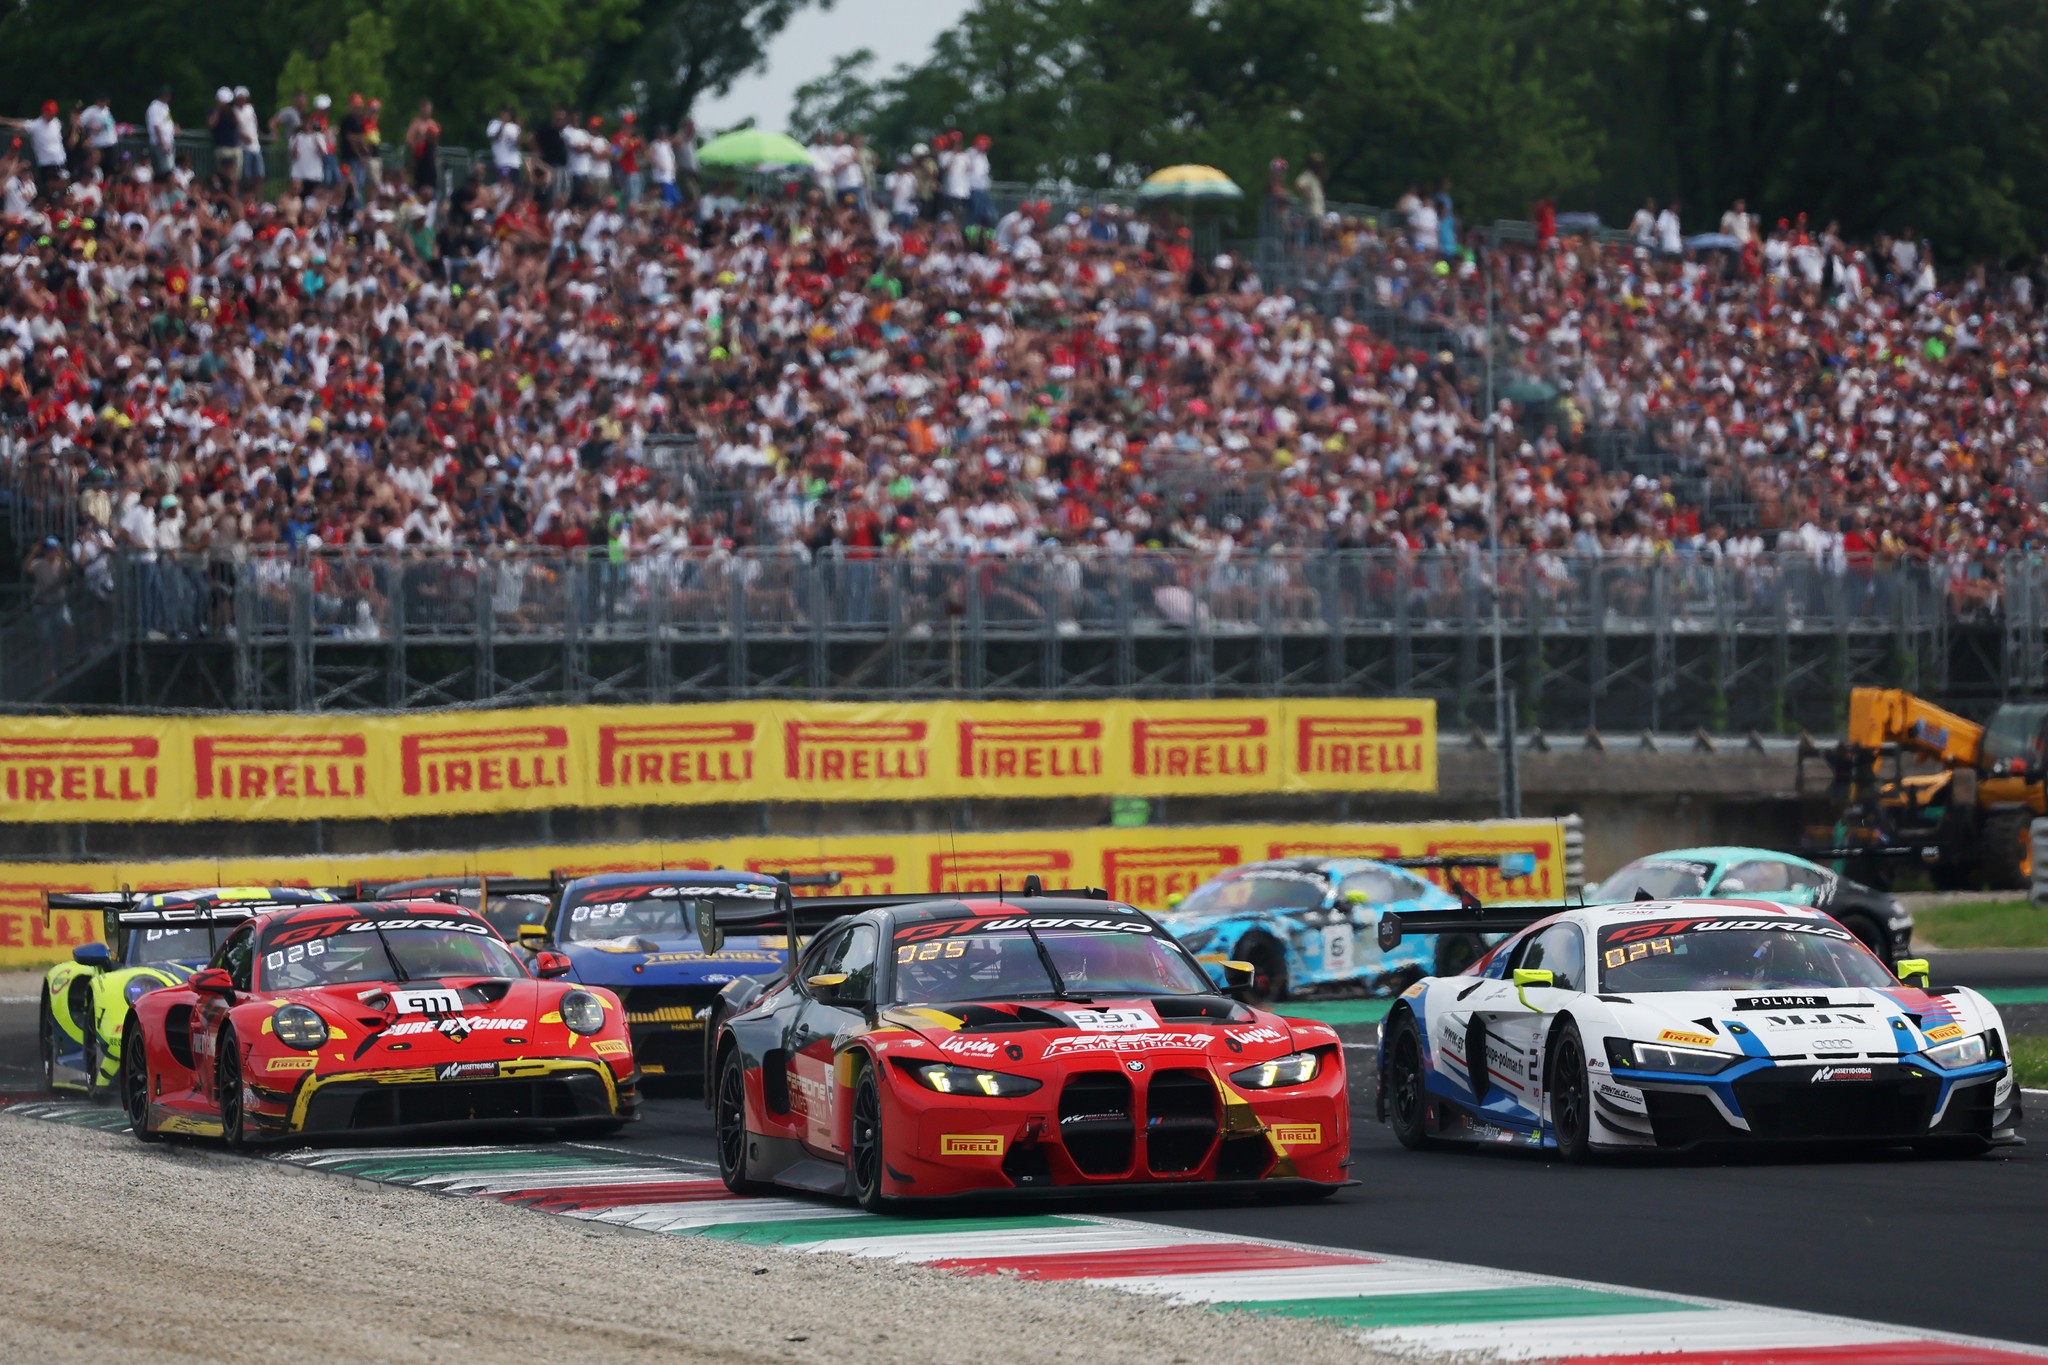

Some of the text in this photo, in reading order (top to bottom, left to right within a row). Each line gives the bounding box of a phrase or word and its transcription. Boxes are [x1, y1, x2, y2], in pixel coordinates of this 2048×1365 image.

[785, 720, 927, 781] PIRELLI
[956, 719, 1102, 778] PIRELLI
[1133, 717, 1267, 776] PIRELLI
[1298, 717, 1422, 773] PIRELLI
[403, 726, 568, 796] PIRELLI
[598, 722, 755, 787] PIRELLI
[194, 733, 366, 798] PIRELLI
[571, 902, 628, 922] 029
[346, 919, 489, 935] WORLD
[982, 918, 1153, 933] WORLD
[1692, 920, 1852, 940] WORLD
[268, 938, 325, 971] 026
[1604, 938, 1672, 969] 024
[409, 996, 452, 1014] 911
[1750, 997, 1816, 1007] POLMAR
[1073, 1011, 1143, 1024] 991
[377, 1020, 438, 1037] PURE
[1662, 1031, 1712, 1044] PIRELLI
[1928, 1025, 1961, 1040] PIRELLI
[595, 1042, 628, 1052] PIRELLI
[271, 1059, 314, 1069] PIRELLI
[1276, 1127, 1317, 1141] PIRELLI
[946, 1138, 999, 1152] PIRELLI
